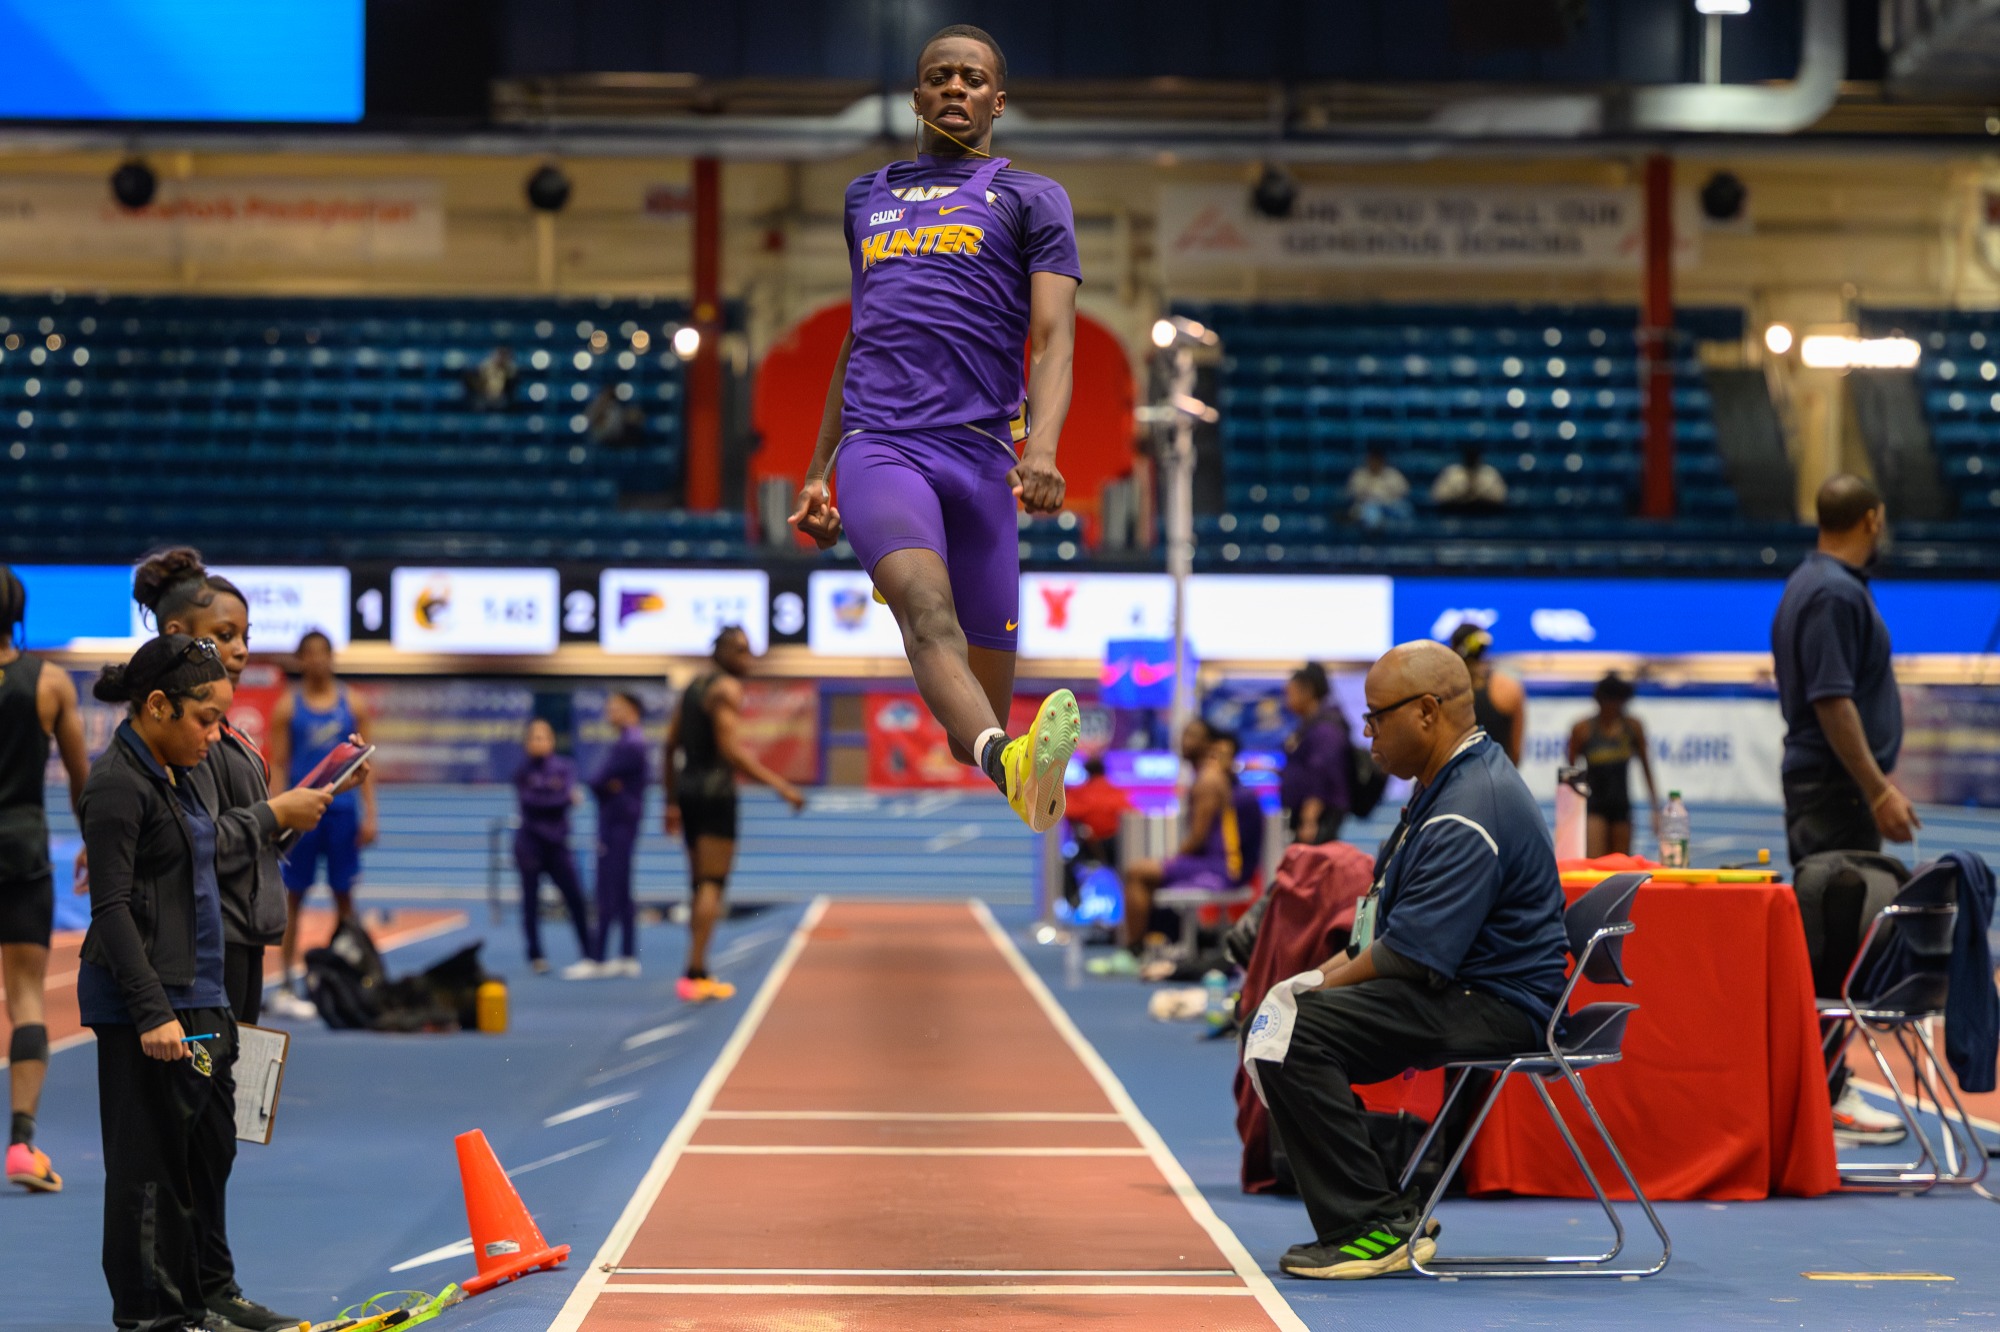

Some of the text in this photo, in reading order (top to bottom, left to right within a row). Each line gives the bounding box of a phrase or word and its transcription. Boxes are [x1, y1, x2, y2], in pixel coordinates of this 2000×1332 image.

[869, 207, 907, 227] CUNY
[861, 223, 985, 273] HUNTER
[356, 588, 383, 632] 1
[563, 589, 595, 633] 2
[773, 591, 805, 635] 3
